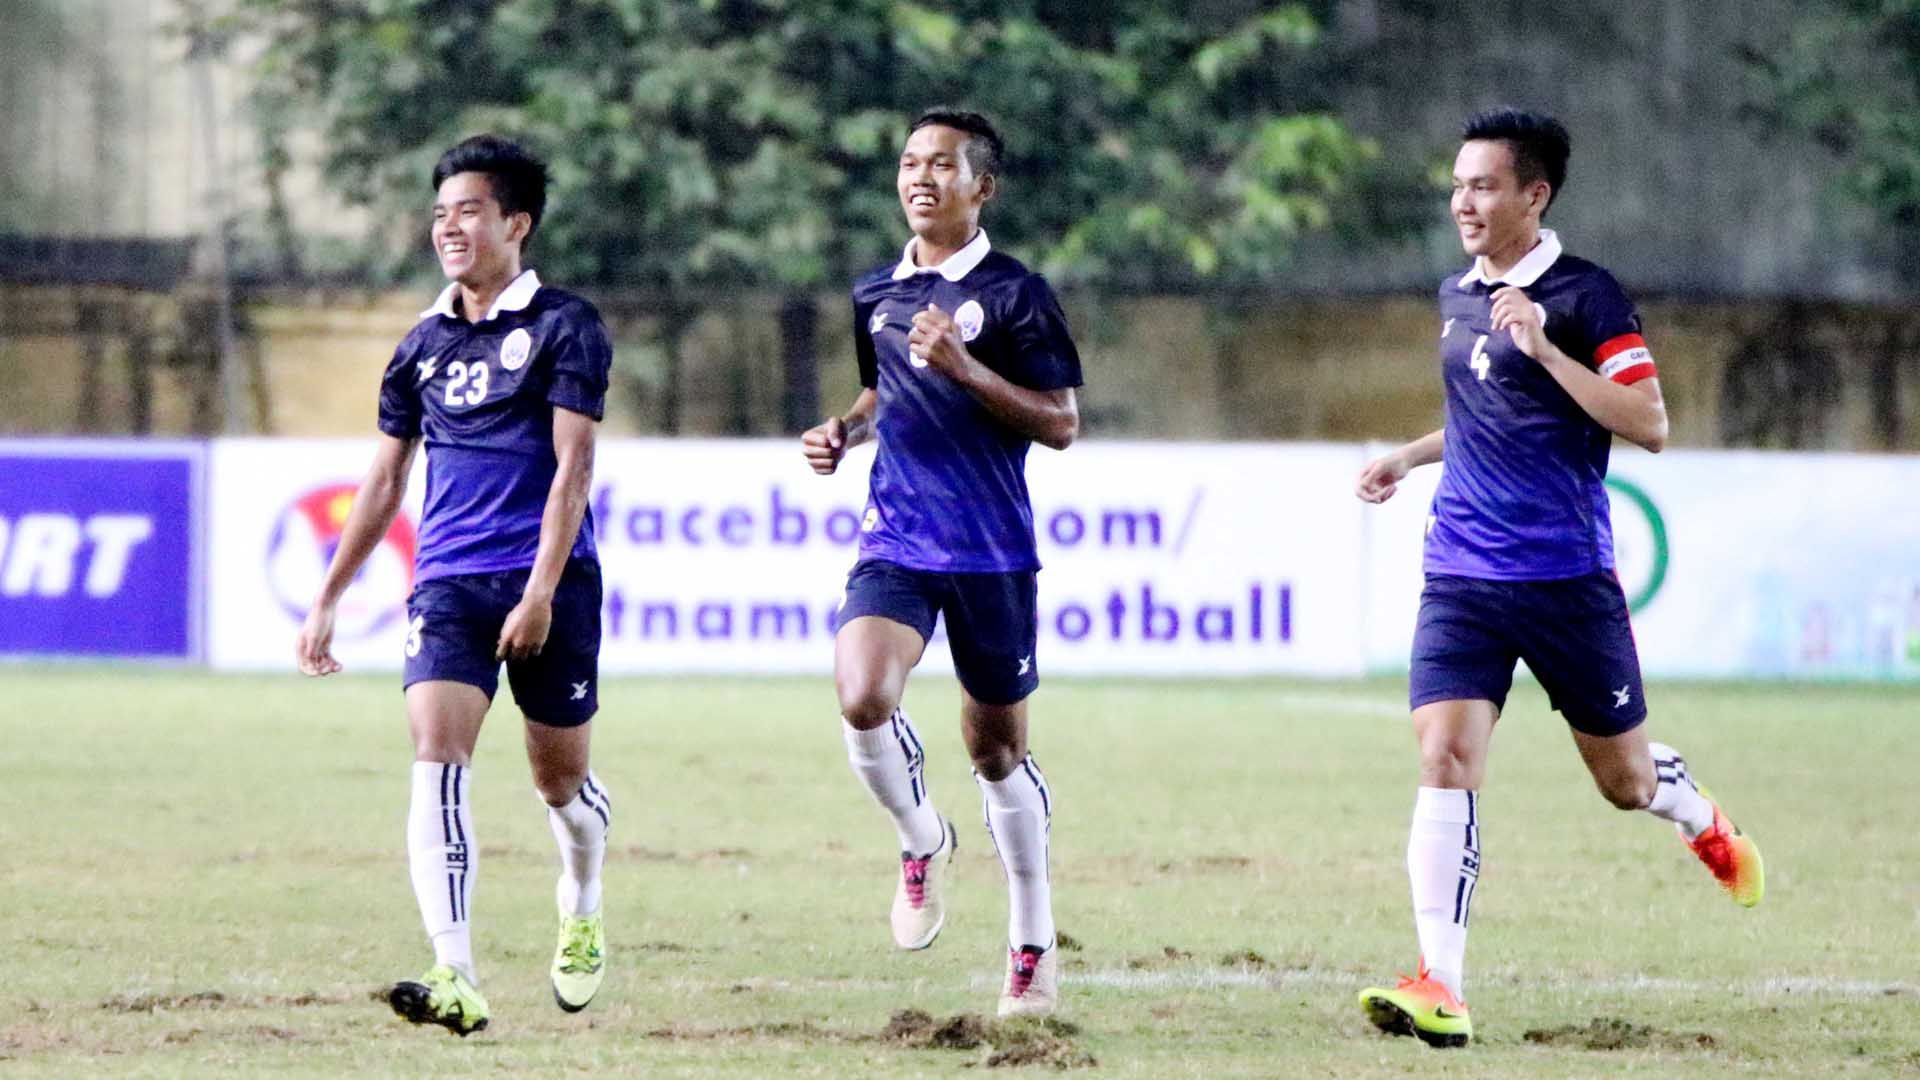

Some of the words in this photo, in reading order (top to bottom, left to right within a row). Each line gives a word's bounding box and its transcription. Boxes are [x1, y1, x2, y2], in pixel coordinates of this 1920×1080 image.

[444, 360, 489, 405] 23
[1470, 334, 1491, 380] 4
[592, 484, 861, 545] facebo
[0, 513, 154, 598] RT
[405, 613, 425, 657] 3
[604, 587, 840, 639] tnam
[1054, 581, 1293, 641] otball
